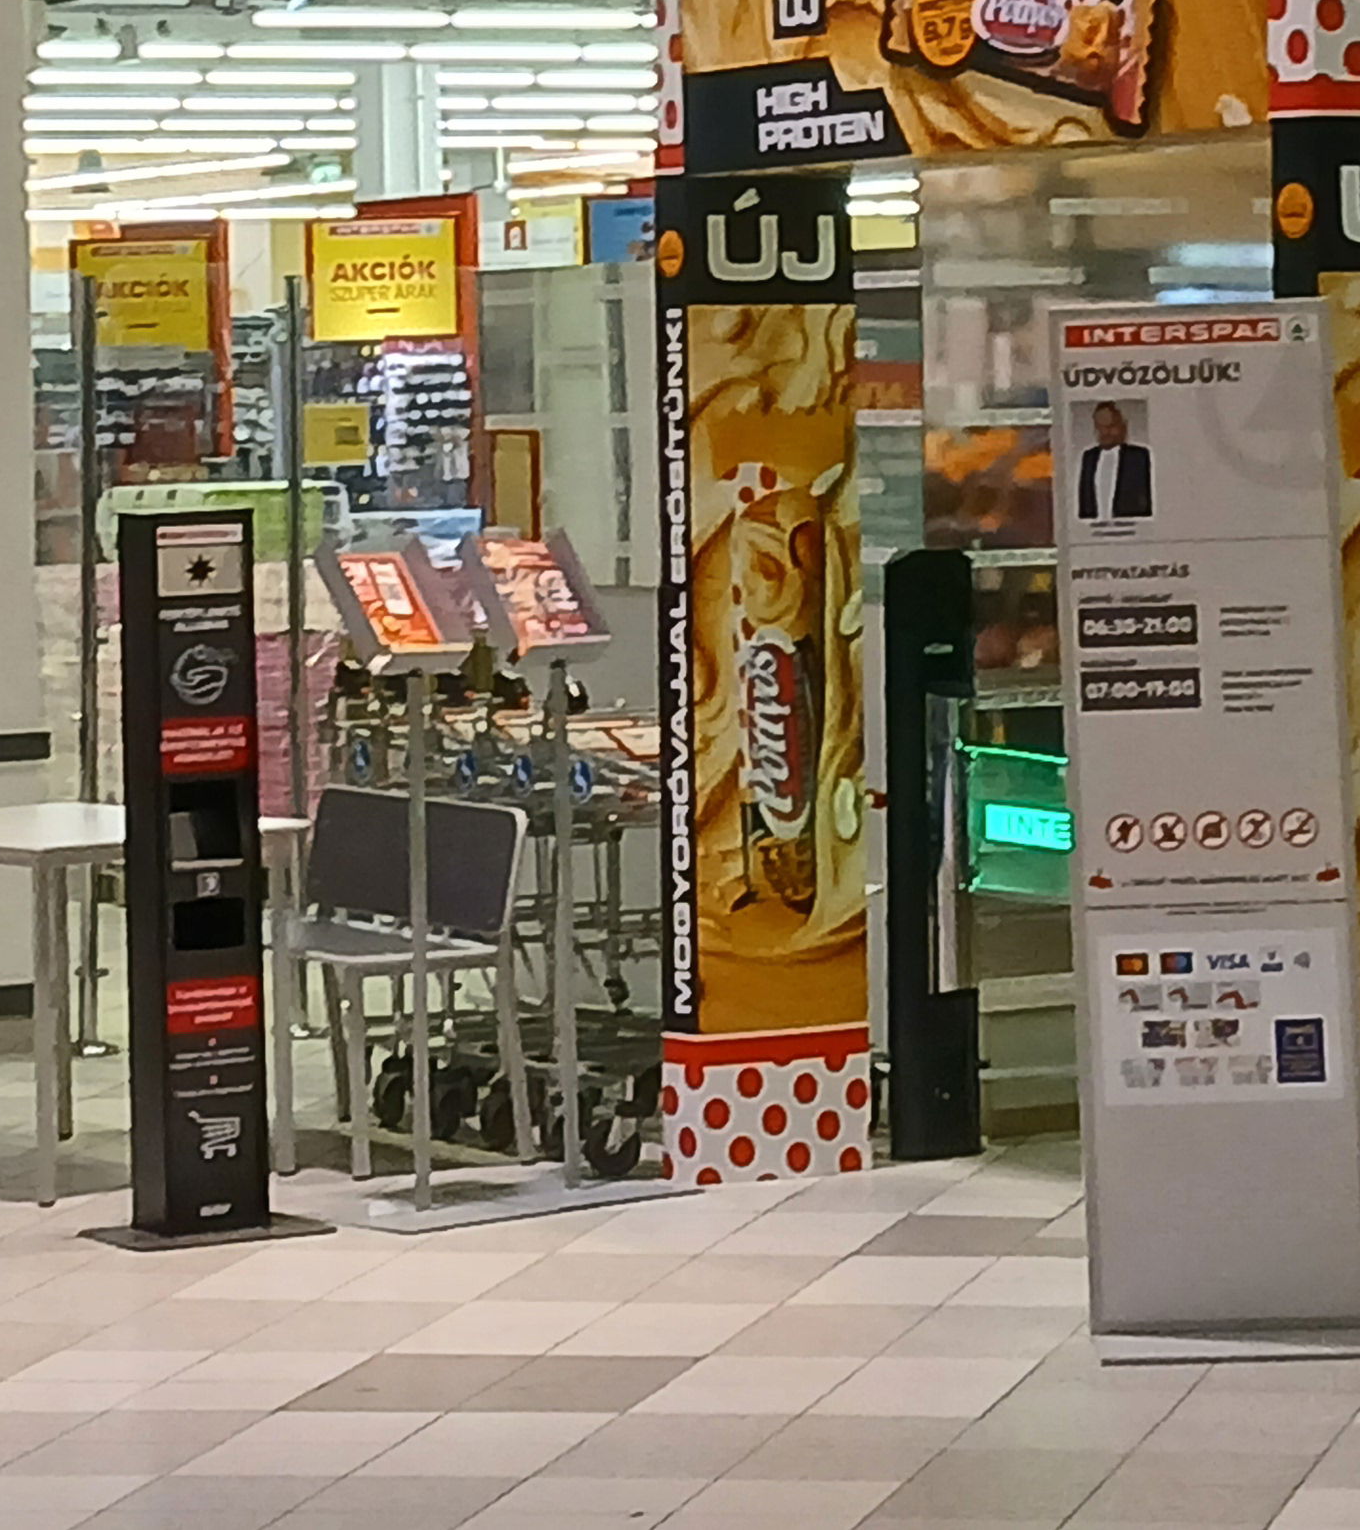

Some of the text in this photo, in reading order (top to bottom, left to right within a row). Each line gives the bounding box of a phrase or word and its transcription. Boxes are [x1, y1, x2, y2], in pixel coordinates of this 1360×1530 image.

[756, 80, 829, 118] HIGH
[757, 110, 886, 153] PROTEIN
[707, 187, 836, 281] ÚJ
[330, 253, 436, 283] AKCIÓK
[1082, 321, 1280, 345] INTERSPAR
[1207, 953, 1250, 970] VISA
